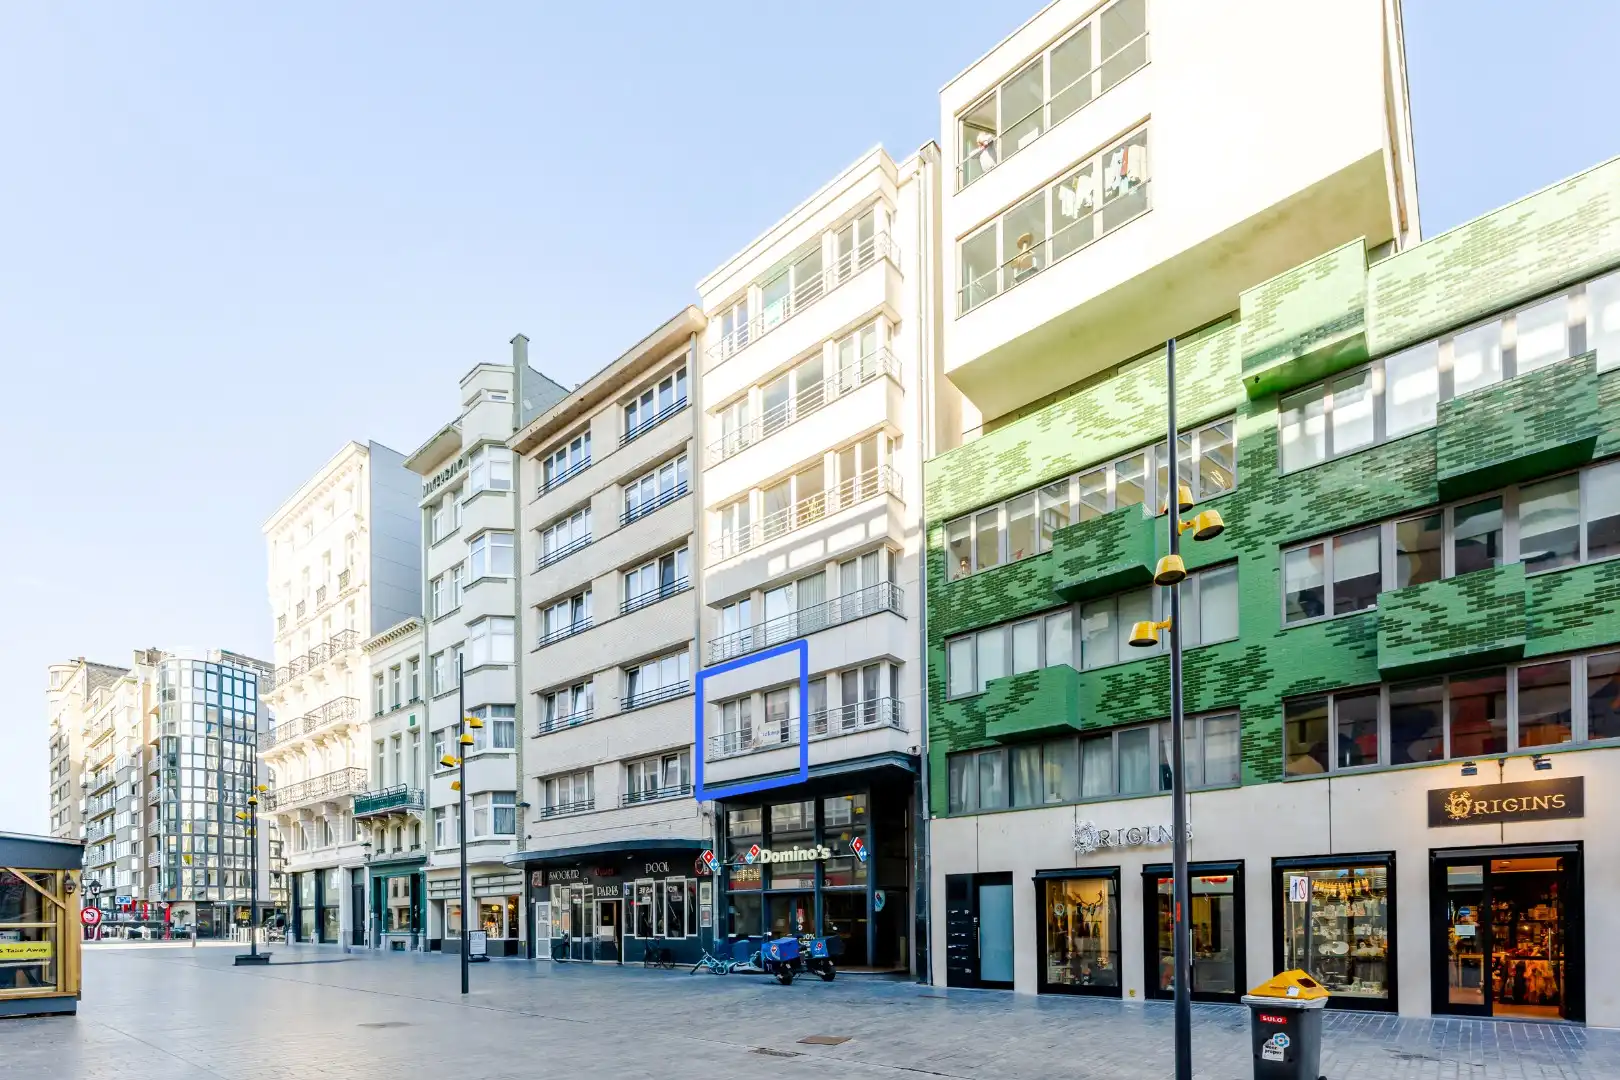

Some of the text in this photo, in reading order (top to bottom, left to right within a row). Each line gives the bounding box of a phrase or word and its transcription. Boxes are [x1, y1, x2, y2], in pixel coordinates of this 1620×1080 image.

[1445, 791, 1565, 820] ORIGINS
[762, 845, 830, 862] Domino's
[645, 862, 669, 873] POOL
[549, 869, 579, 881] SNOOKER
[737, 869, 759, 881] OPEN
[597, 885, 618, 896] PARIS
